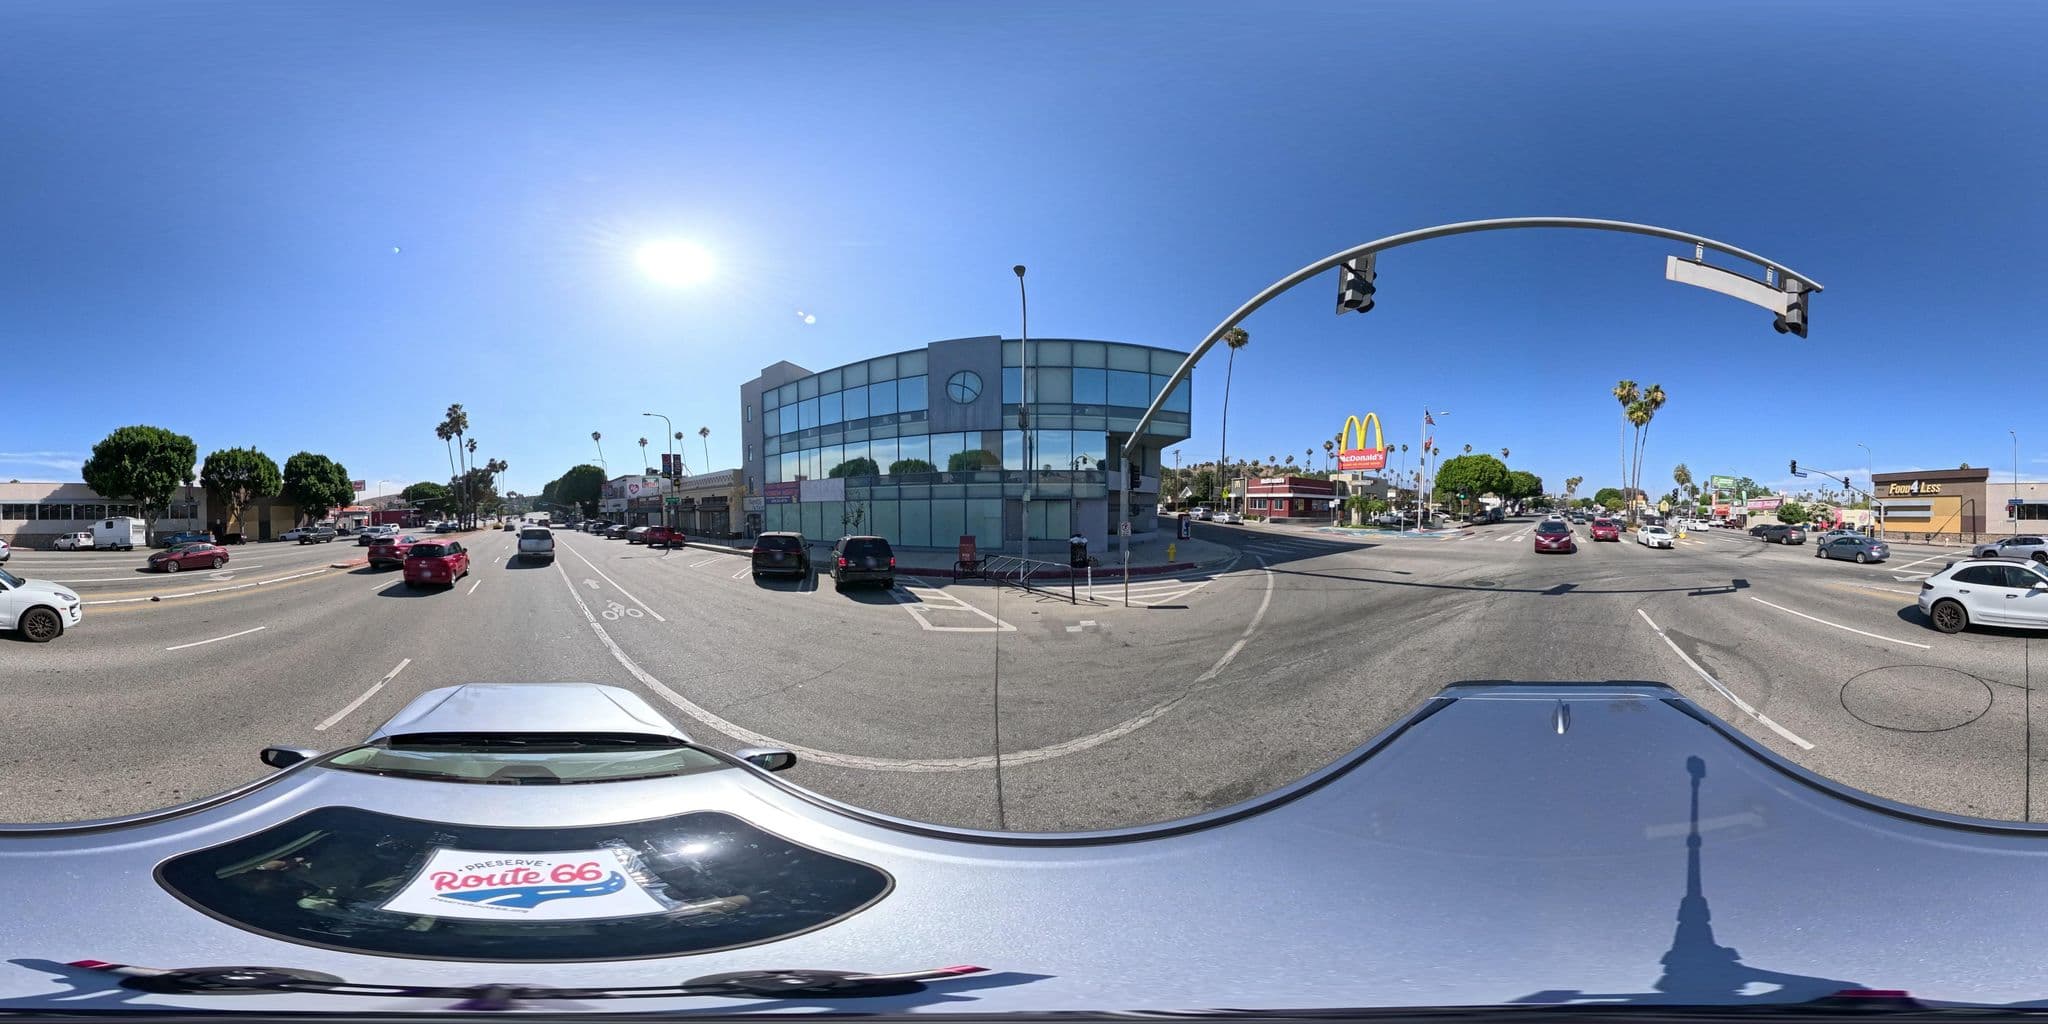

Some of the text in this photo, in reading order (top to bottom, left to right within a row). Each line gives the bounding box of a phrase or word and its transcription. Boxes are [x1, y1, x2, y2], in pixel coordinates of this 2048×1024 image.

[1339, 454, 1383, 462] McDonald's
[1910, 480, 1919, 493] 4
[465, 859, 544, 871] PRESERVE
[430, 862, 602, 890] Route 66
